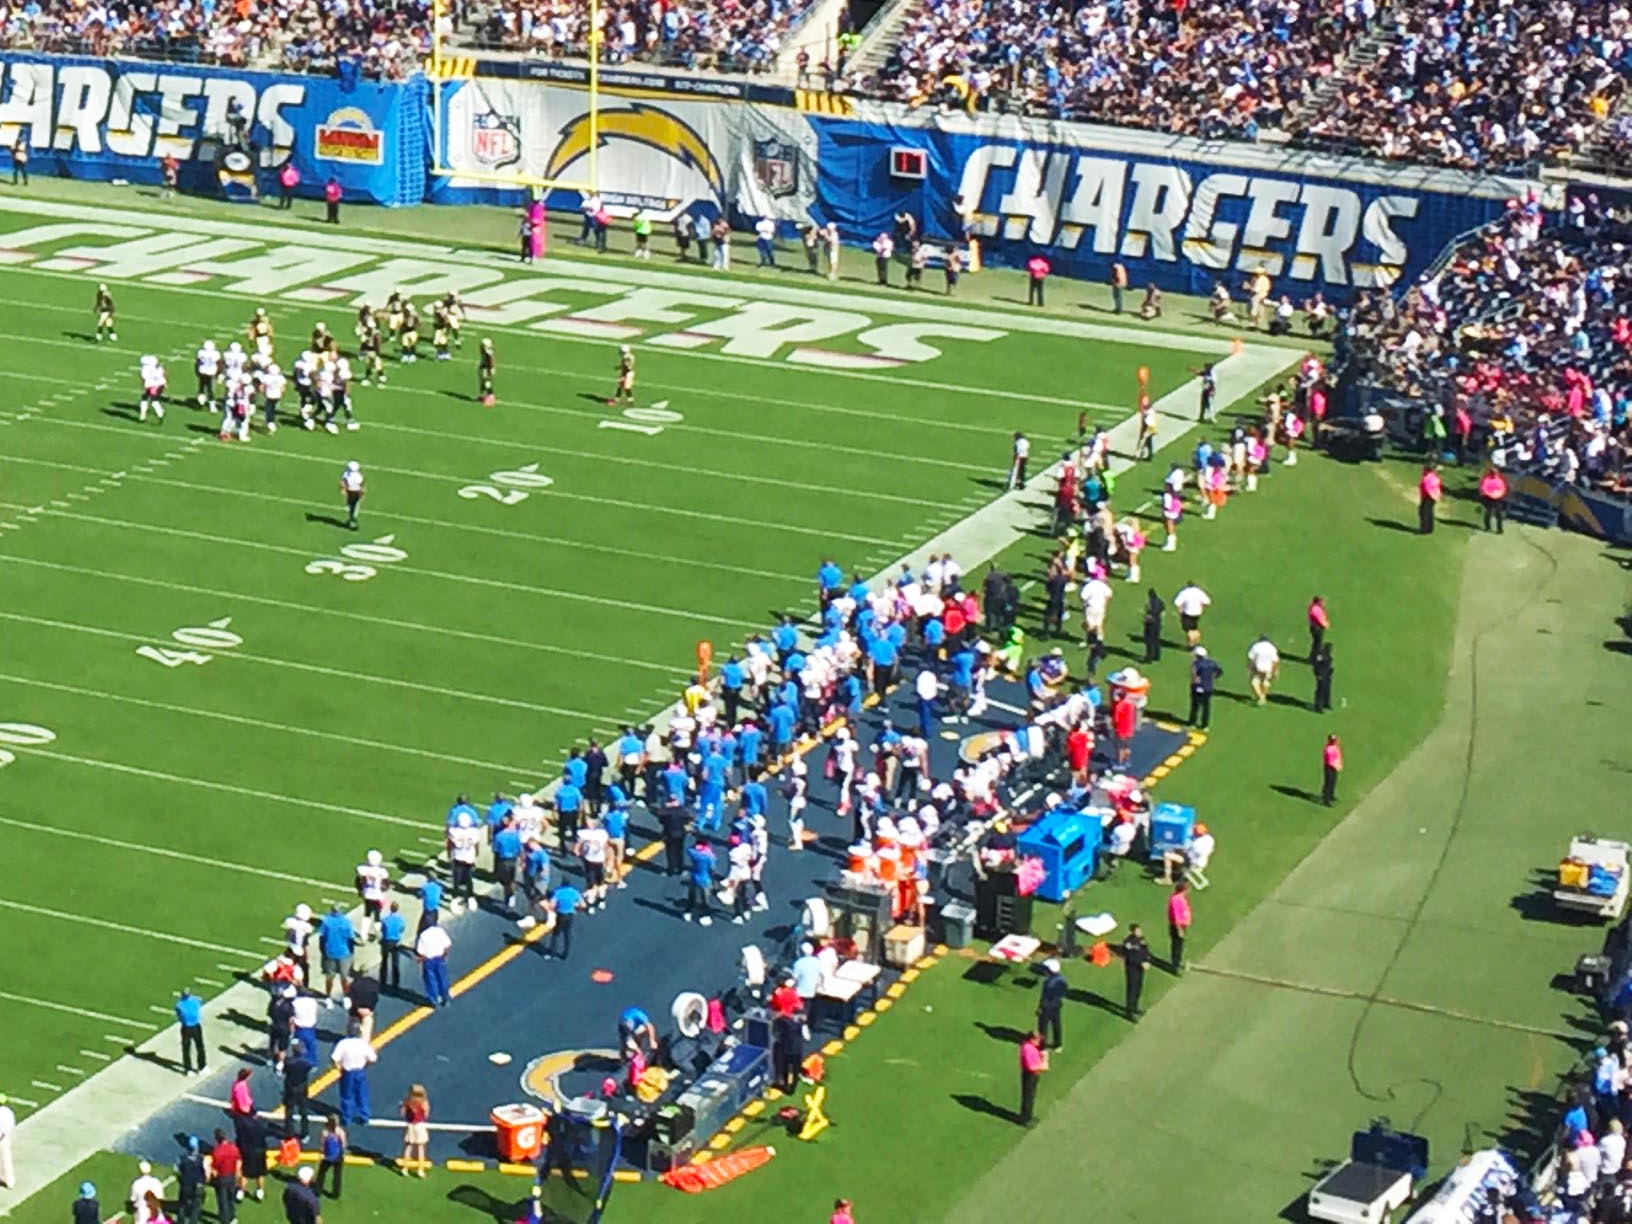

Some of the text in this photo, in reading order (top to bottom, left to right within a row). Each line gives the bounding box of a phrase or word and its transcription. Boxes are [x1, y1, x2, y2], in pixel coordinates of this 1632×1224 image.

[475, 130, 510, 155] NFL
[958, 144, 1419, 289] CHARGERS
[597, 406, 685, 436] 10
[456, 466, 554, 506] 20
[305, 542, 409, 582] 30
[136, 625, 244, 669] 40
